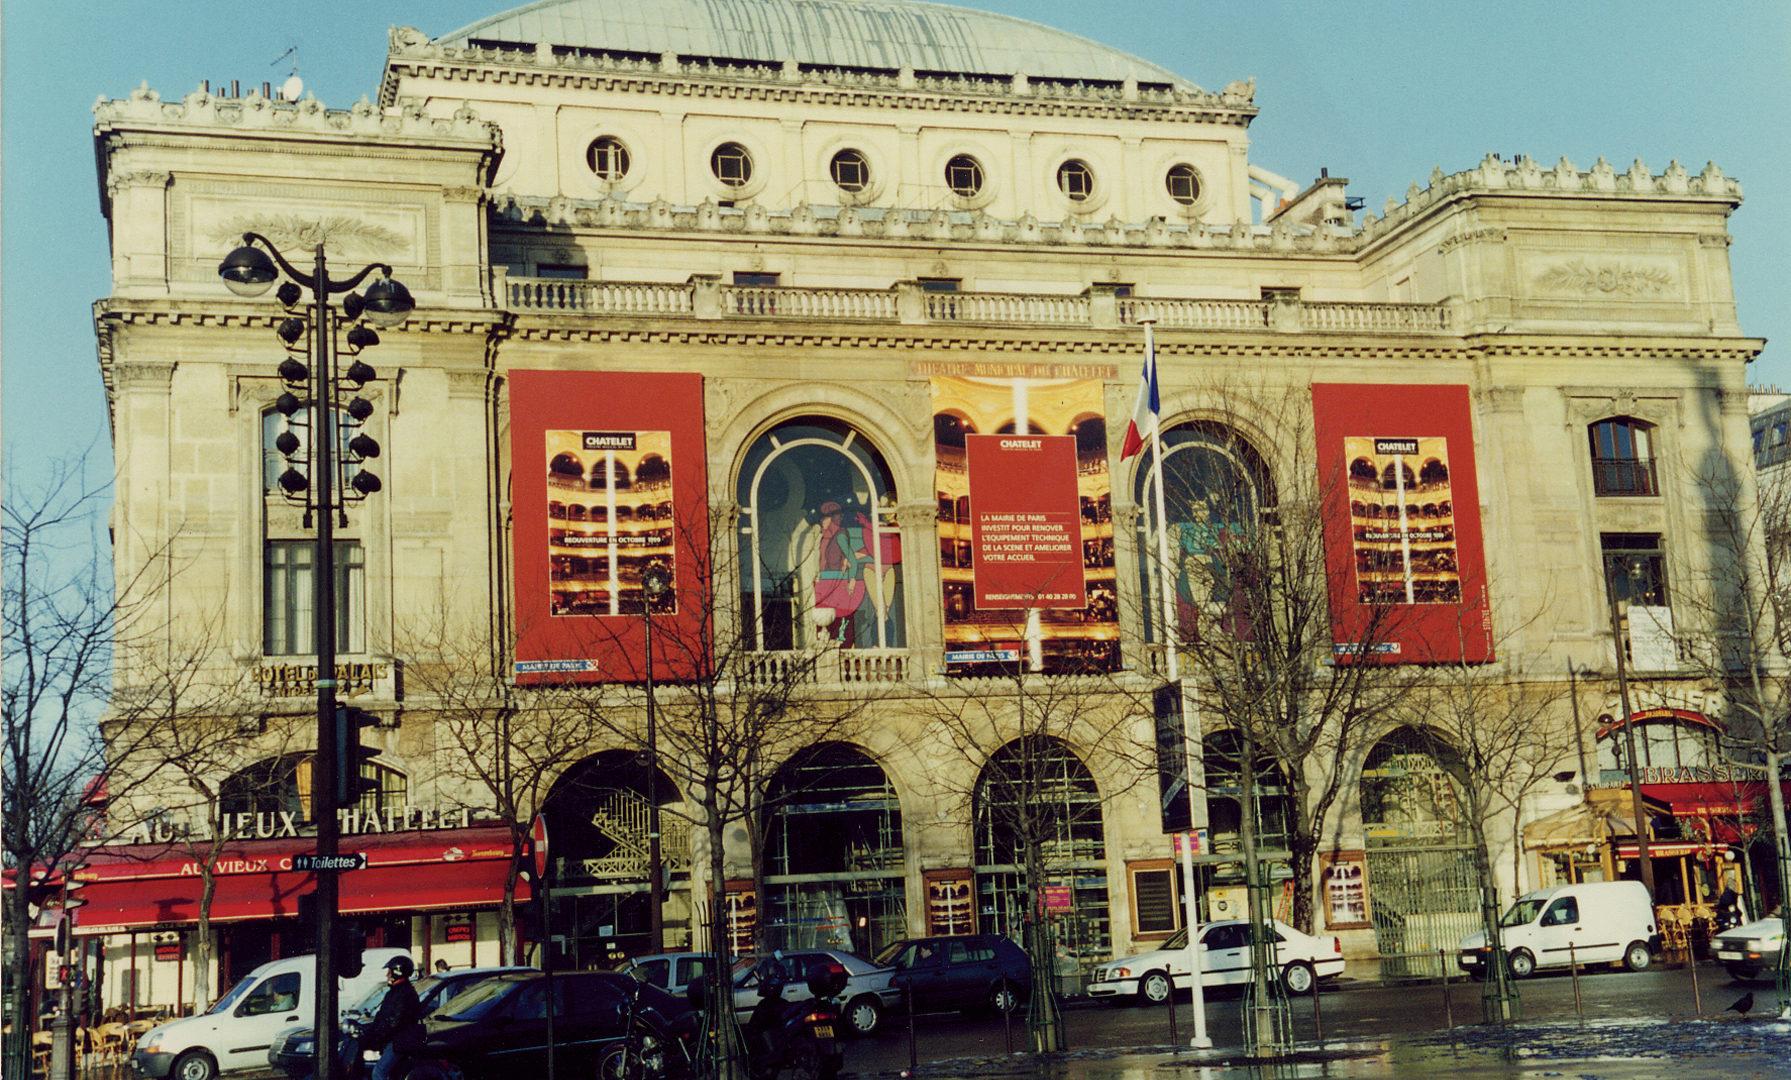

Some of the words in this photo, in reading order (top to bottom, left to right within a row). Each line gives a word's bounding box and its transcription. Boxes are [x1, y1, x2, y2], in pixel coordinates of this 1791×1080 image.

[586, 436, 633, 446] CHATELET
[1000, 440, 1042, 448] CHATELET
[1377, 442, 1416, 451] CHATELET
[1031, 534, 1069, 542] TECHNIQUE
[952, 653, 974, 661] MAIRIE
[335, 663, 388, 680] ALAIS
[338, 805, 471, 835] HATELET
[310, 856, 356, 869] Toilettes
[180, 862, 203, 876] AU
[217, 860, 268, 874] VIEUX
